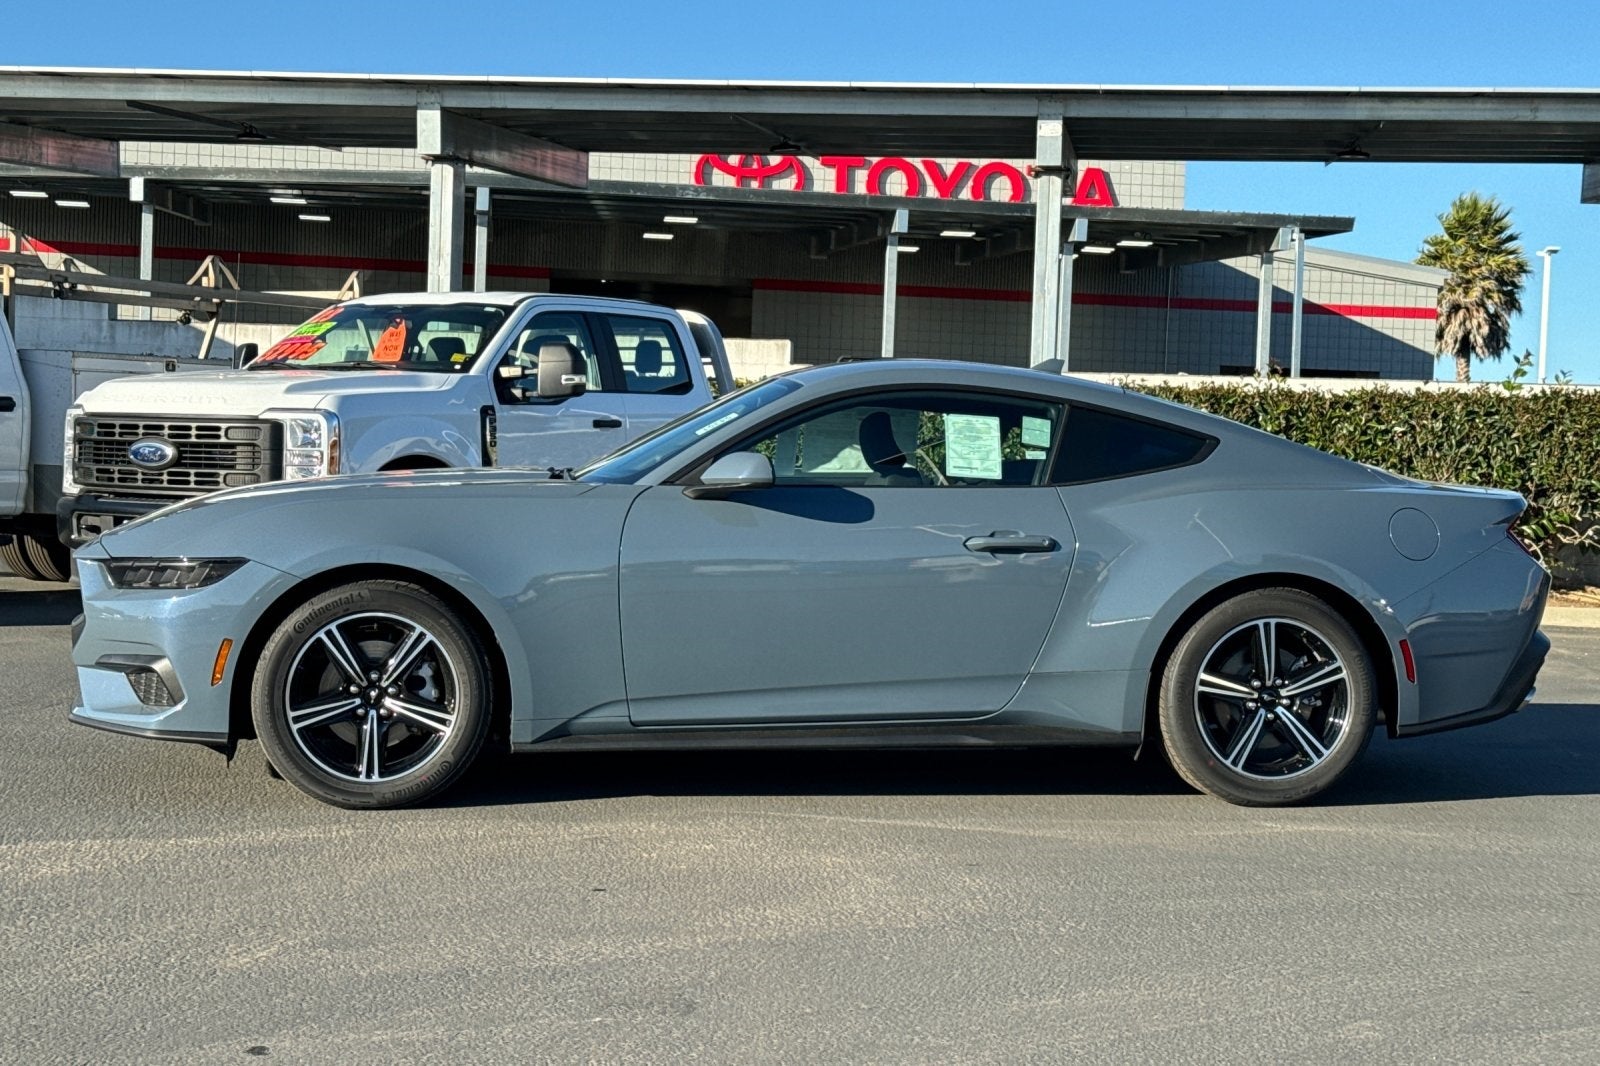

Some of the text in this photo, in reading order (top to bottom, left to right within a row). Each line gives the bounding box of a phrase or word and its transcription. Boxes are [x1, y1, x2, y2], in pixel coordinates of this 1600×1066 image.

[820, 155, 1113, 207] TOYOA
[293, 593, 355, 634] Continental
[392, 760, 452, 799] Continental
